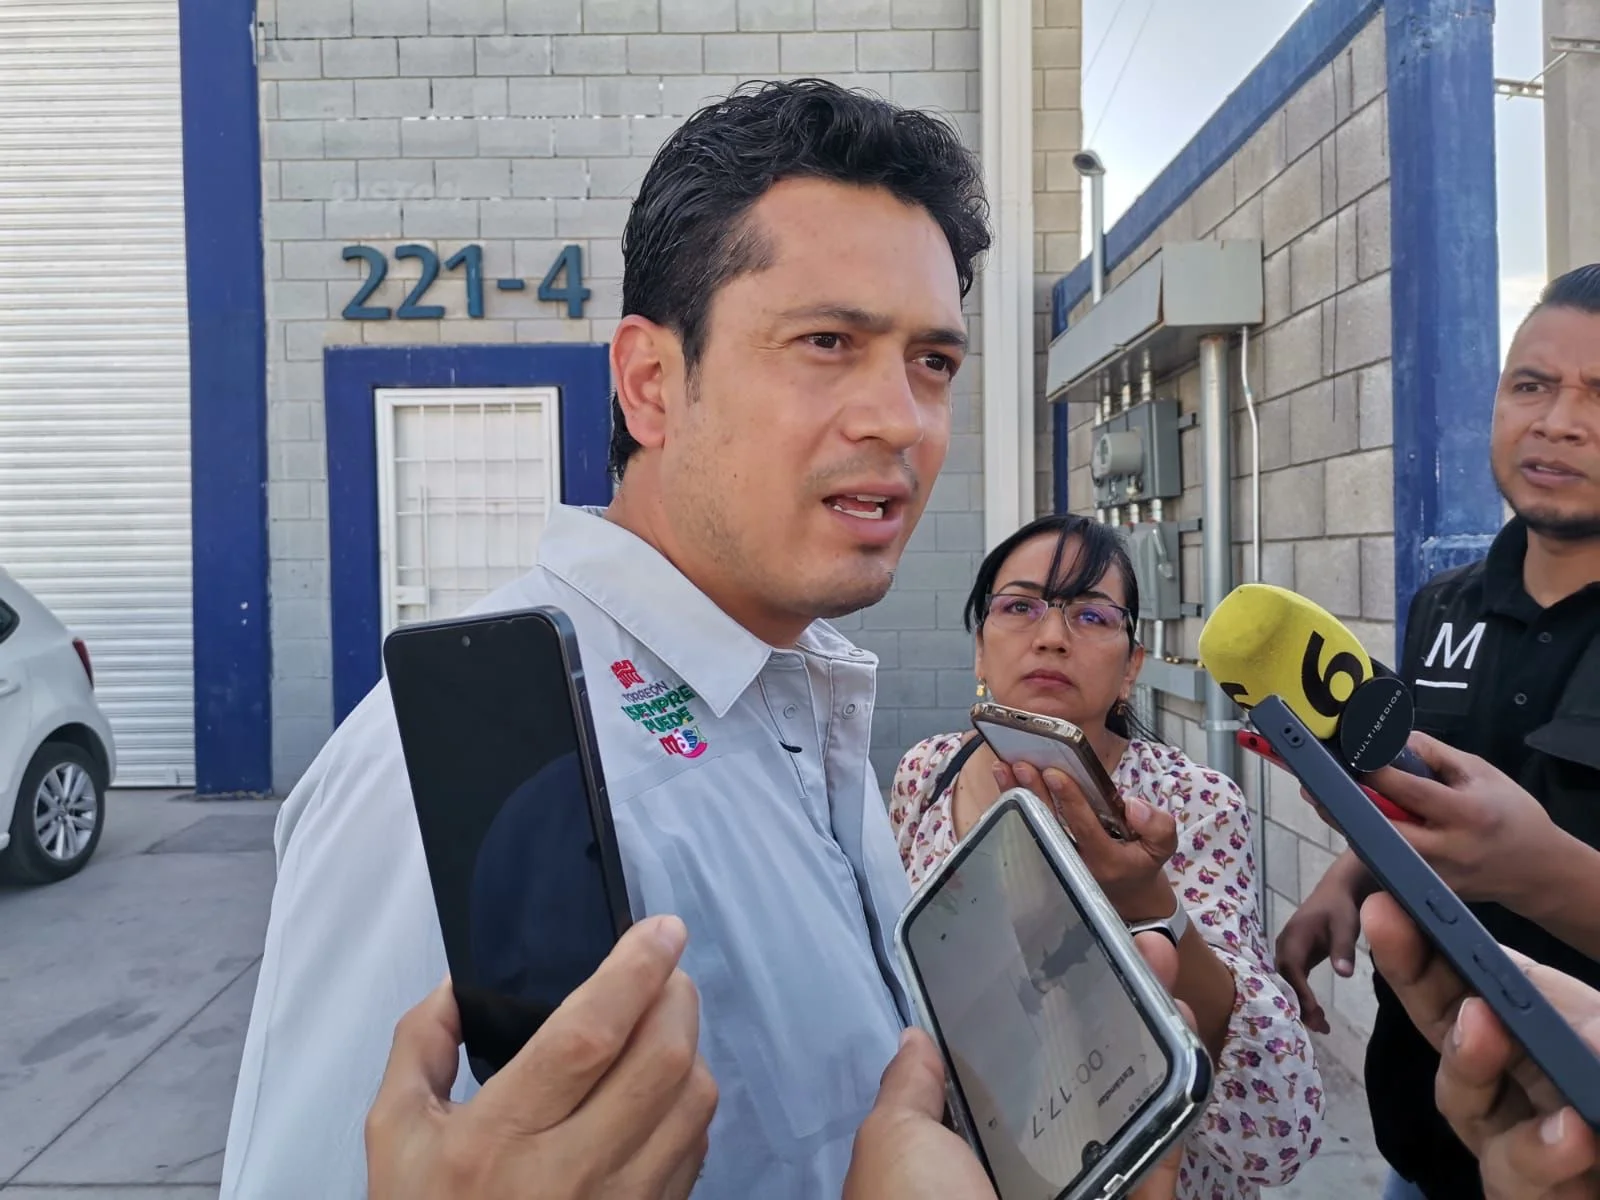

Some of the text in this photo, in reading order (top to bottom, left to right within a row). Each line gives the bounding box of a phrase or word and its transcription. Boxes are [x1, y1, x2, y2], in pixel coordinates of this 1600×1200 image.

[341, 243, 592, 320] 221-4
[1302, 630, 1364, 718] 6
[1424, 621, 1487, 669] M
[1353, 689, 1402, 760] MULTIMEDIOS
